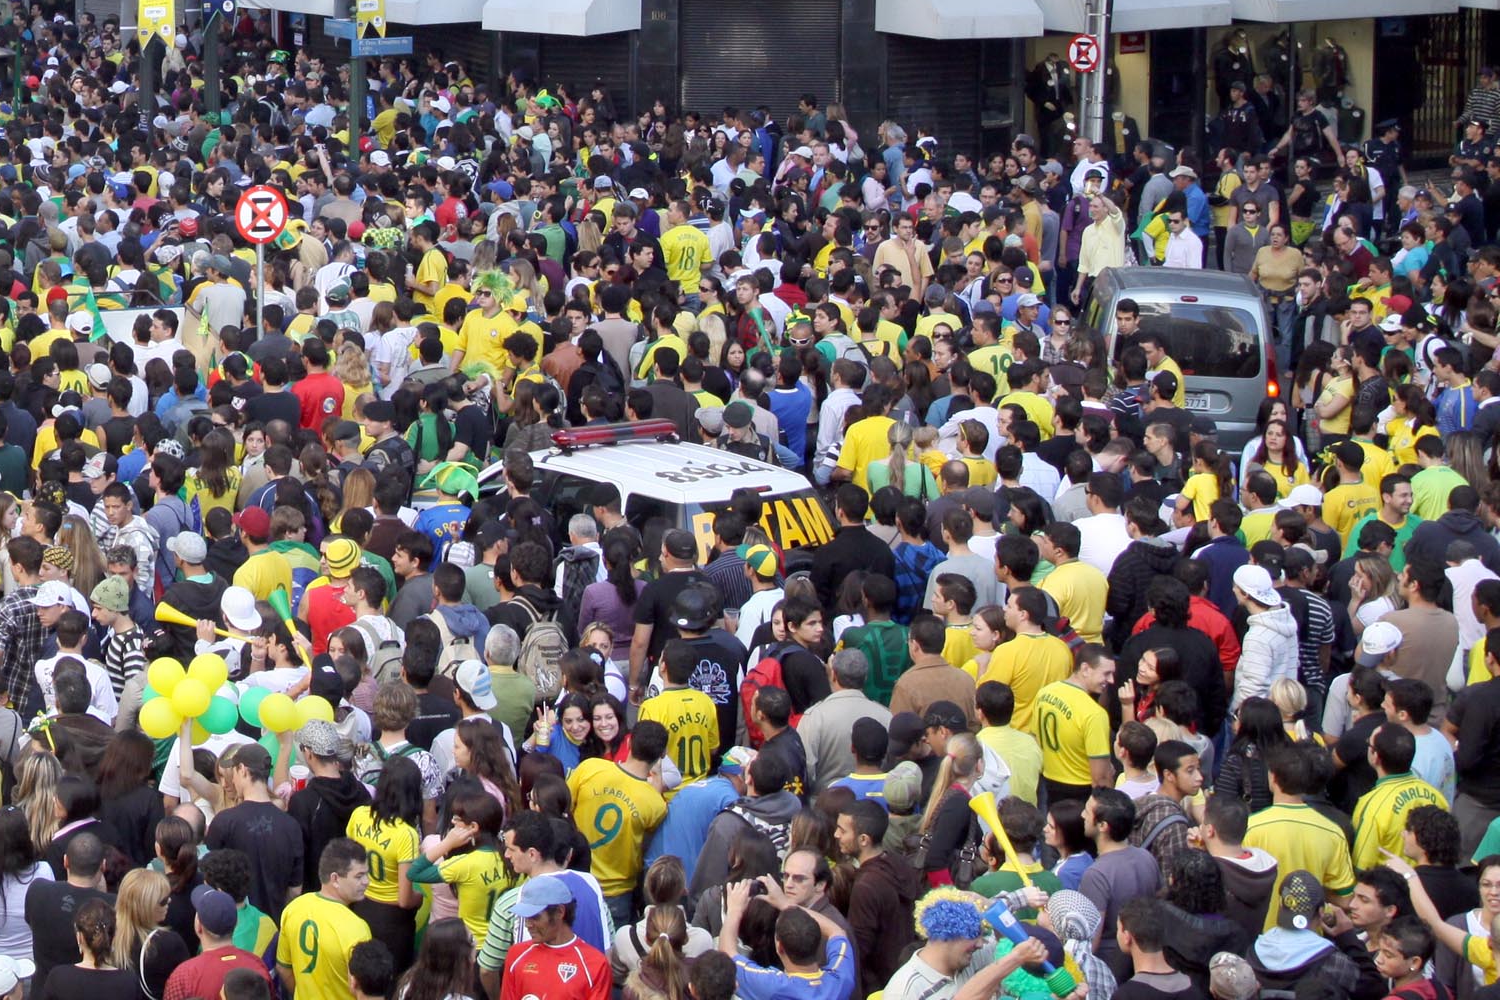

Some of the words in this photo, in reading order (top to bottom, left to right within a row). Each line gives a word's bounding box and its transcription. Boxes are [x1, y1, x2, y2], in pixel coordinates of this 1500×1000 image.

[679, 246, 695, 271] 18
[434, 520, 466, 537] BRS
[692, 497, 835, 568] RTAM
[1038, 707, 1060, 752] 10
[677, 734, 707, 778] 10
[1392, 786, 1437, 815] RONALDO
[590, 803, 623, 850] 9
[367, 850, 385, 883] 0
[299, 919, 319, 974] 9
